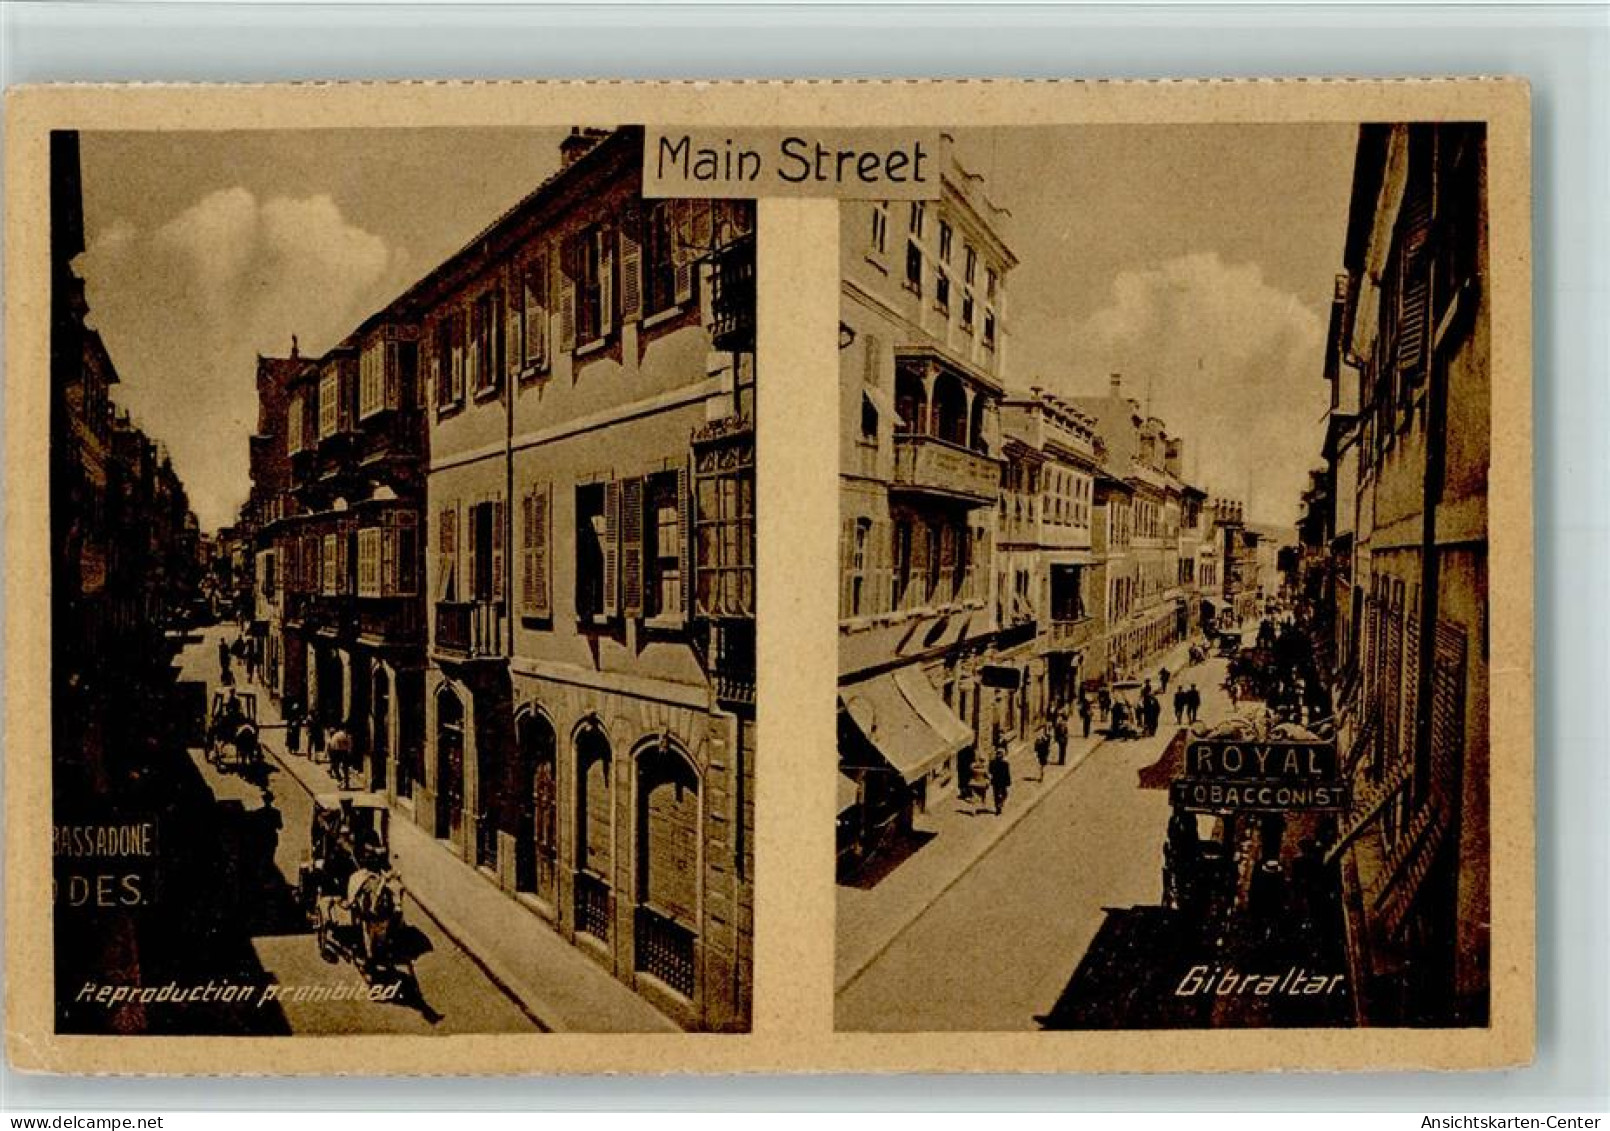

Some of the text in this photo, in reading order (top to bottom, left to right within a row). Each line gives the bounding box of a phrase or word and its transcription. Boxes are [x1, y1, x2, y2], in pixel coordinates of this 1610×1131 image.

[1196, 745, 1323, 775] ROYAL
[1176, 783, 1345, 806] TOBACCONIST
[52, 873, 150, 907] DES.
